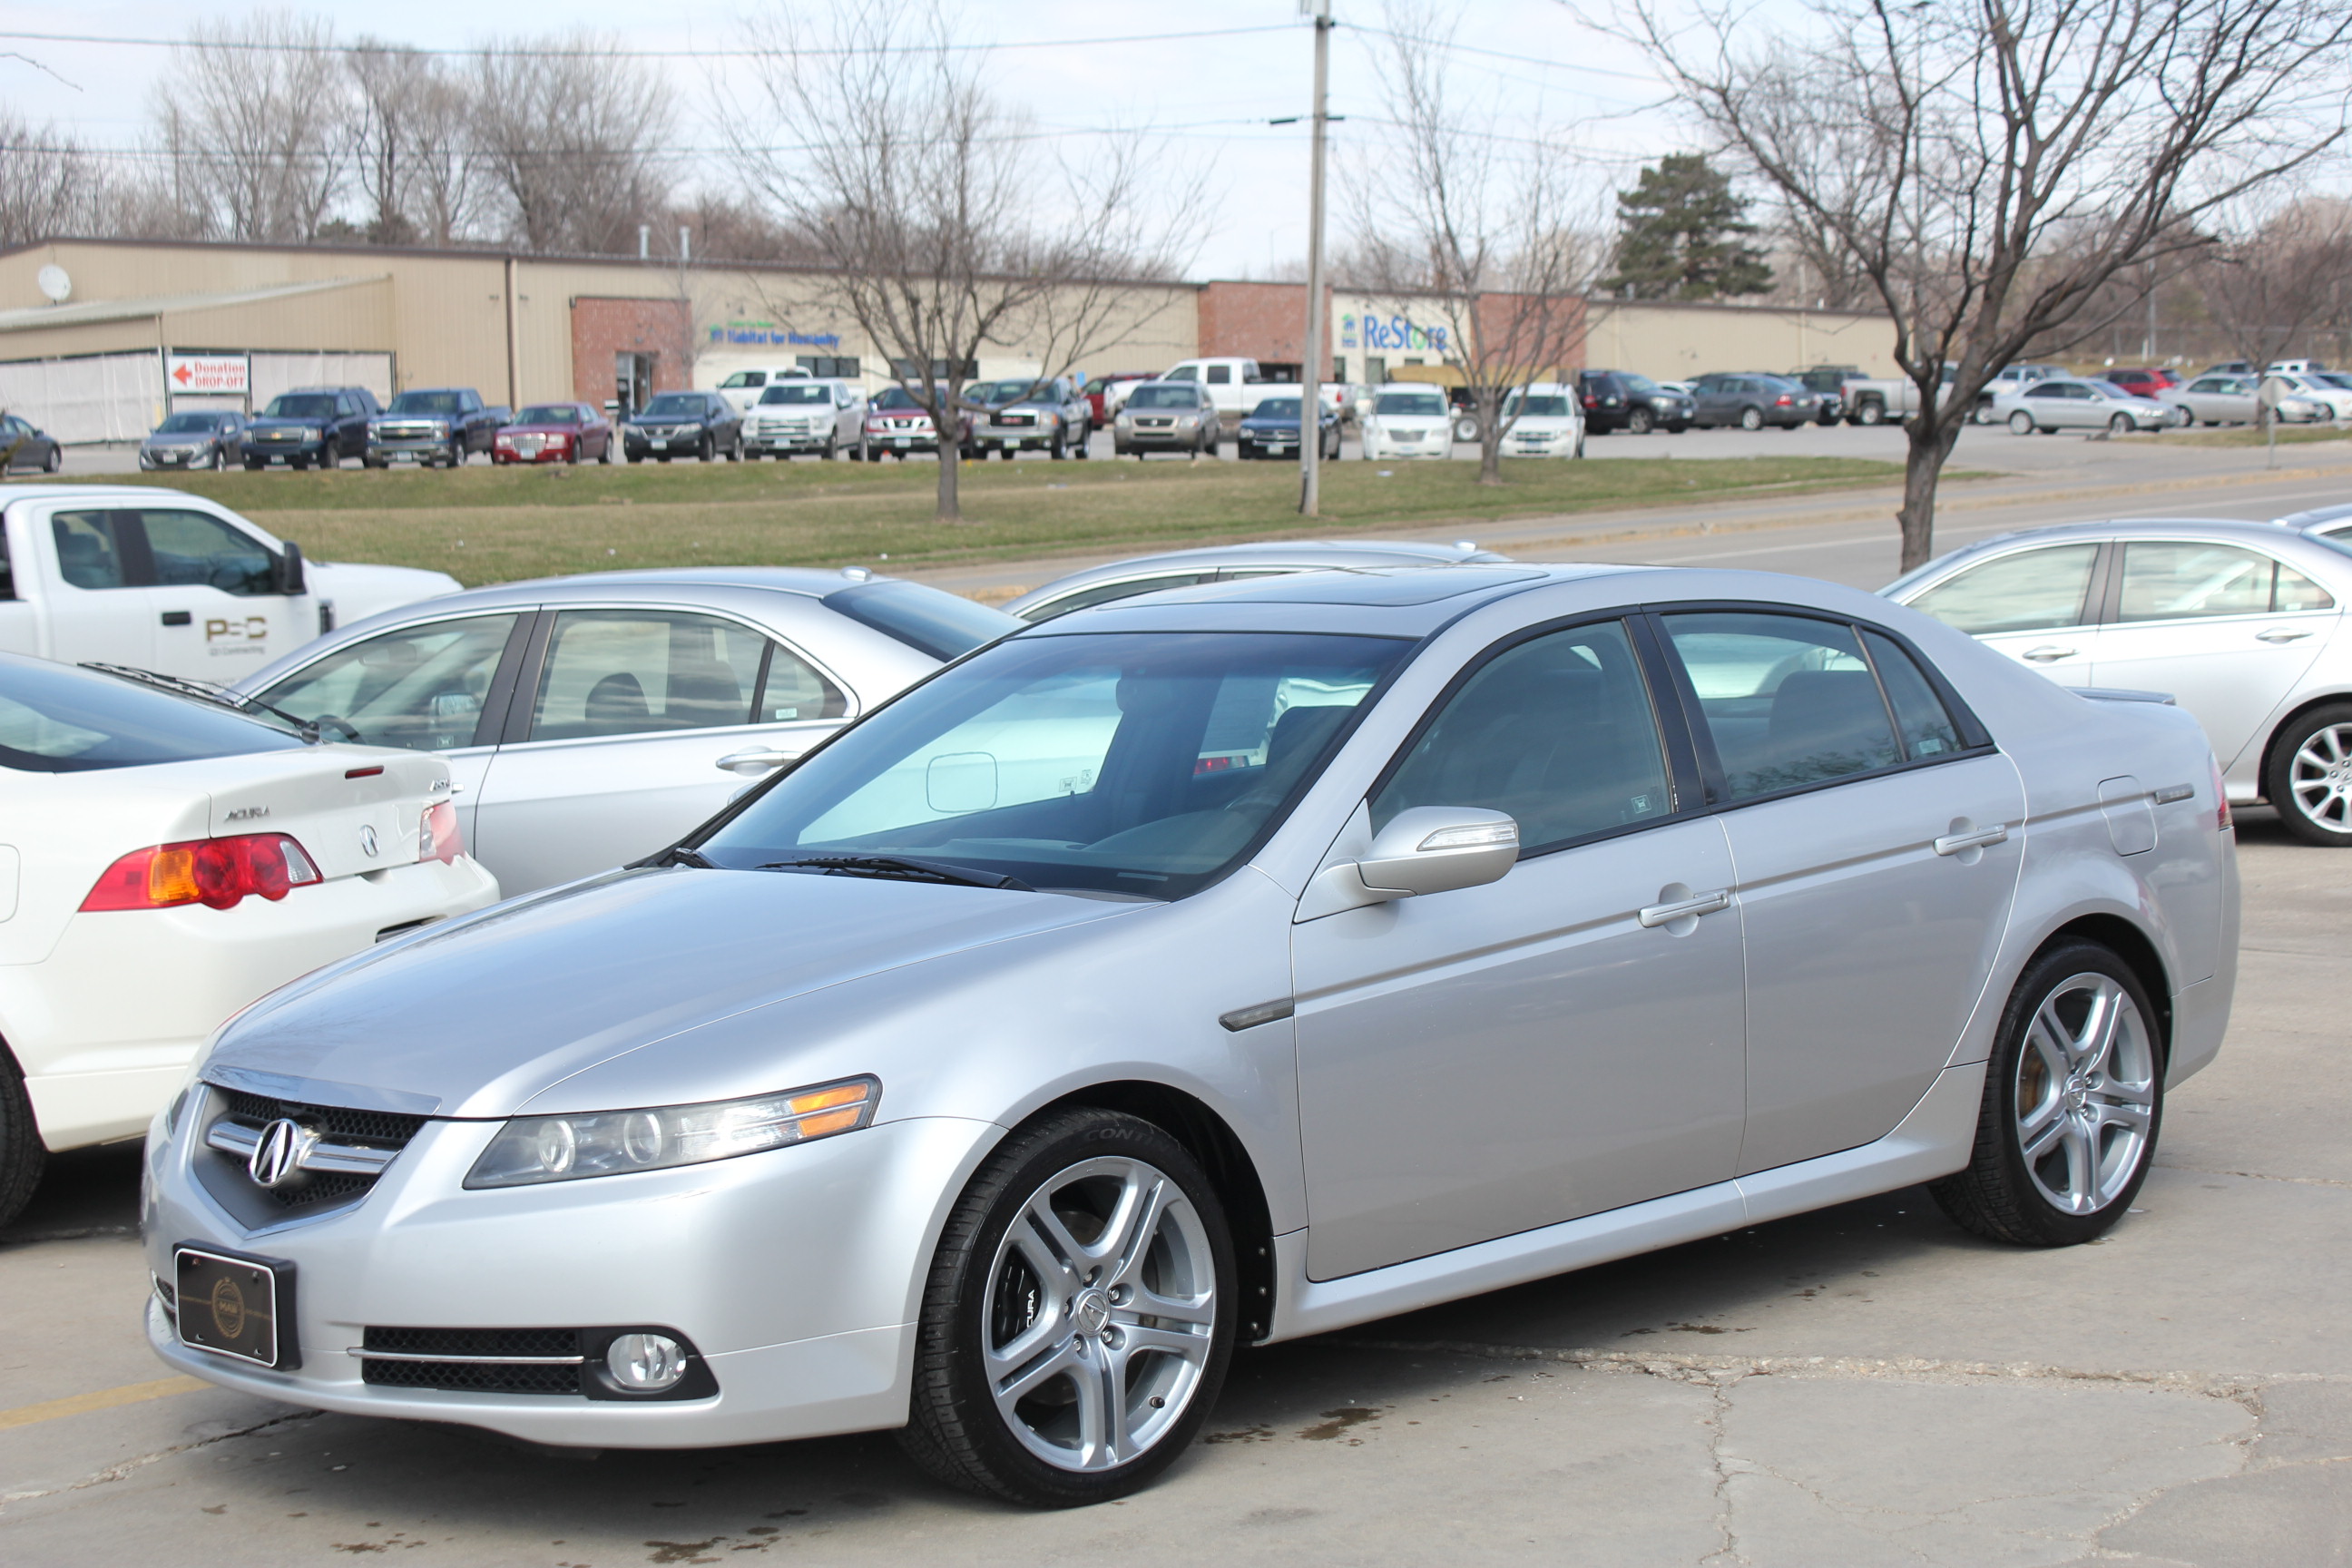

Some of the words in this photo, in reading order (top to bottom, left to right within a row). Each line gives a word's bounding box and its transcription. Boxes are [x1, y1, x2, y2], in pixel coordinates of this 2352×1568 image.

[728, 329, 767, 344] Habitat
[771, 329, 785, 344] for
[789, 330, 839, 348] Humanity
[1364, 315, 1447, 351] ReStore
[194, 361, 246, 373] Donation
[195, 376, 245, 388] DROP-OFF
[223, 806, 270, 823] ACURA
[1026, 1289, 1035, 1328] CURA
